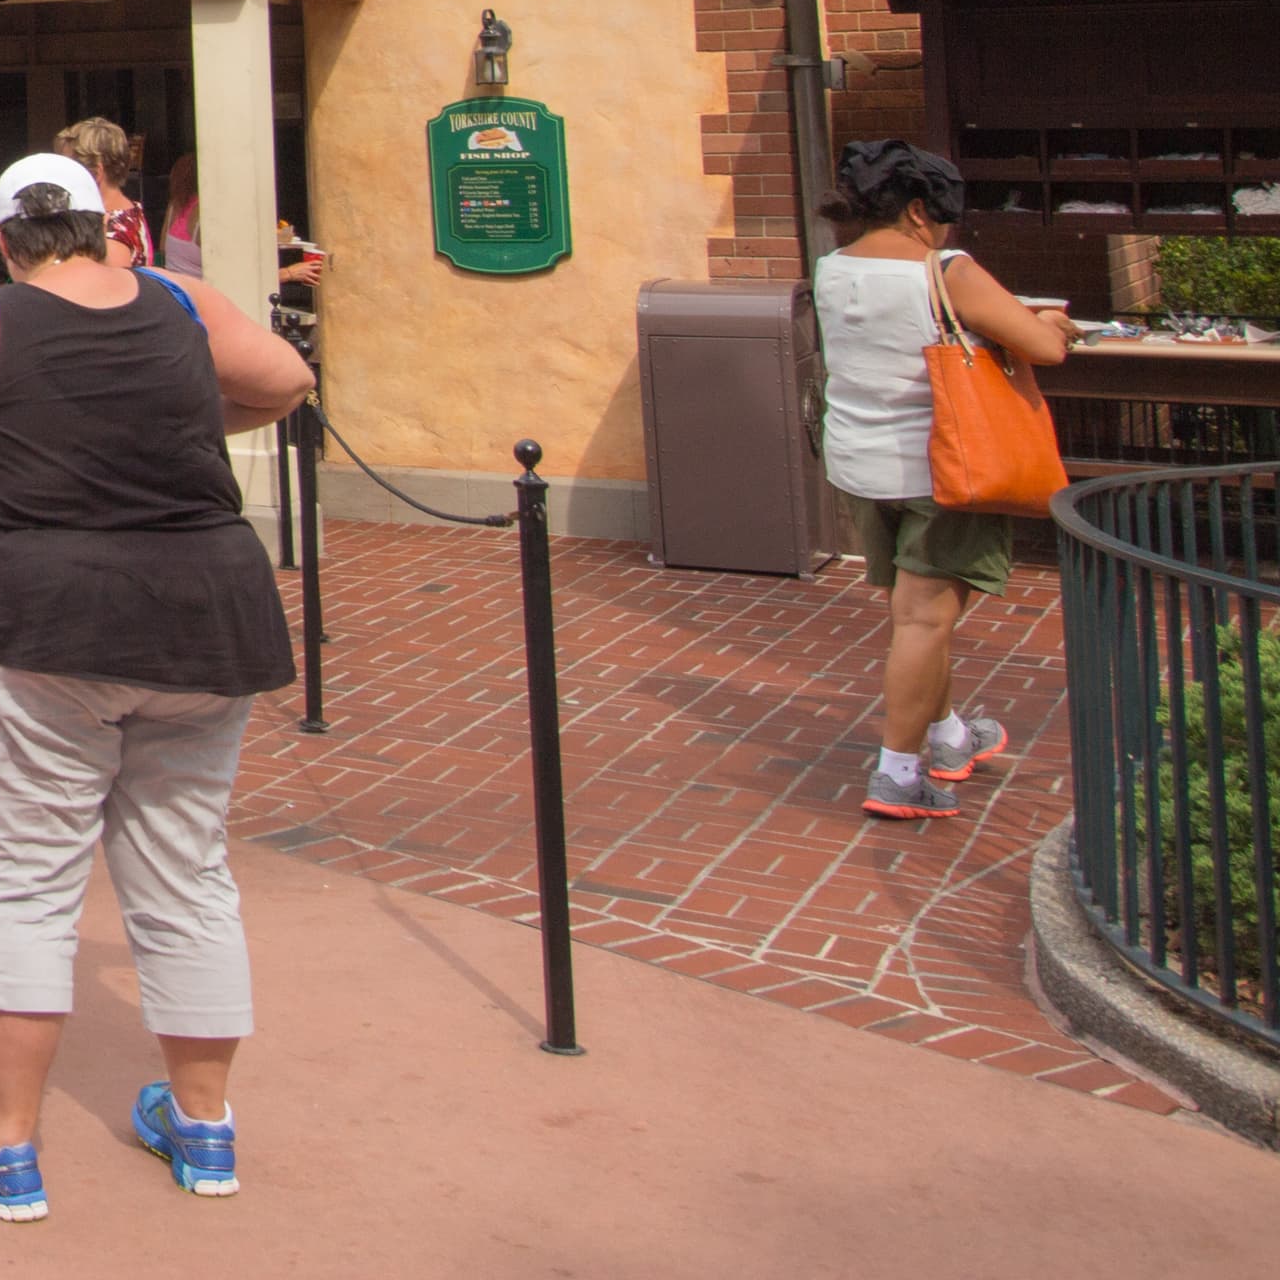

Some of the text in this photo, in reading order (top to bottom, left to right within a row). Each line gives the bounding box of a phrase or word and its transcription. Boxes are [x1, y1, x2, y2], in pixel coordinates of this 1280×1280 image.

[449, 111, 537, 133] YORKSHIRE COUNTY
[493, 151, 531, 160] SHOP
